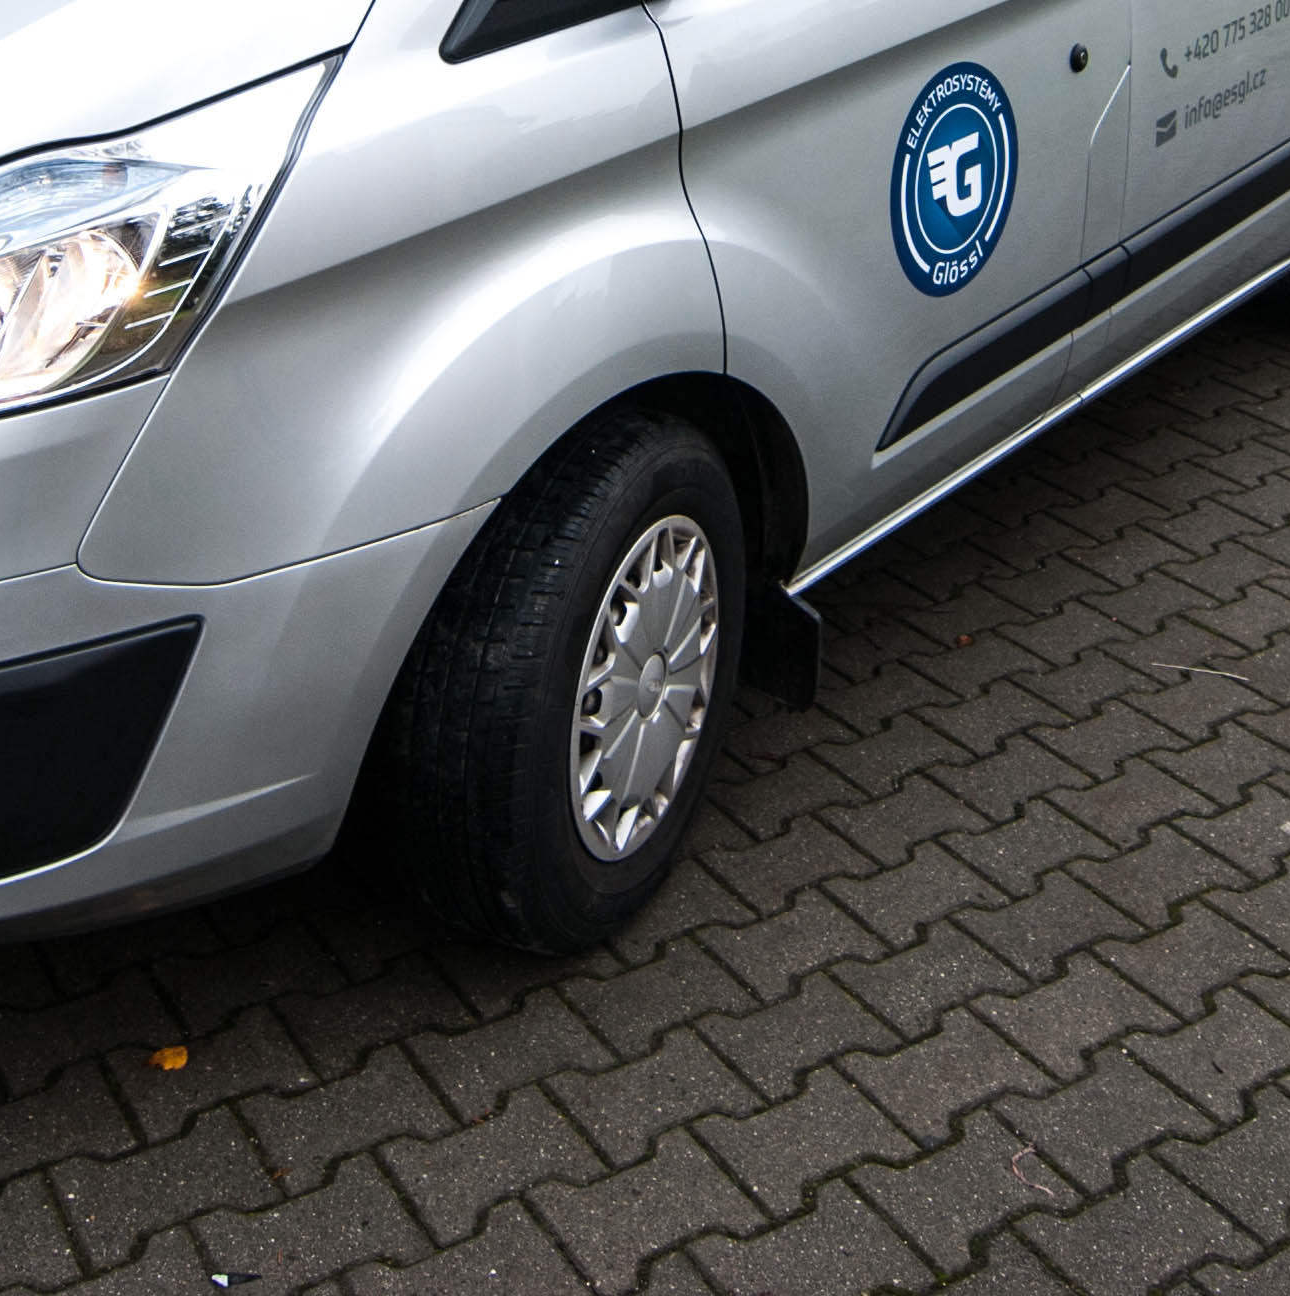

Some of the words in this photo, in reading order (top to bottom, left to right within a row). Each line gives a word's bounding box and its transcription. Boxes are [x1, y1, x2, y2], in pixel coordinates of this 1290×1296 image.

[1184, 29, 1220, 62] +420
[1223, 16, 1246, 48] 775
[1249, 4, 1272, 35] 328
[906, 73, 1002, 150] ELEKTROSYSTÉMY
[1184, 68, 1267, 130] info@esgl.cz
